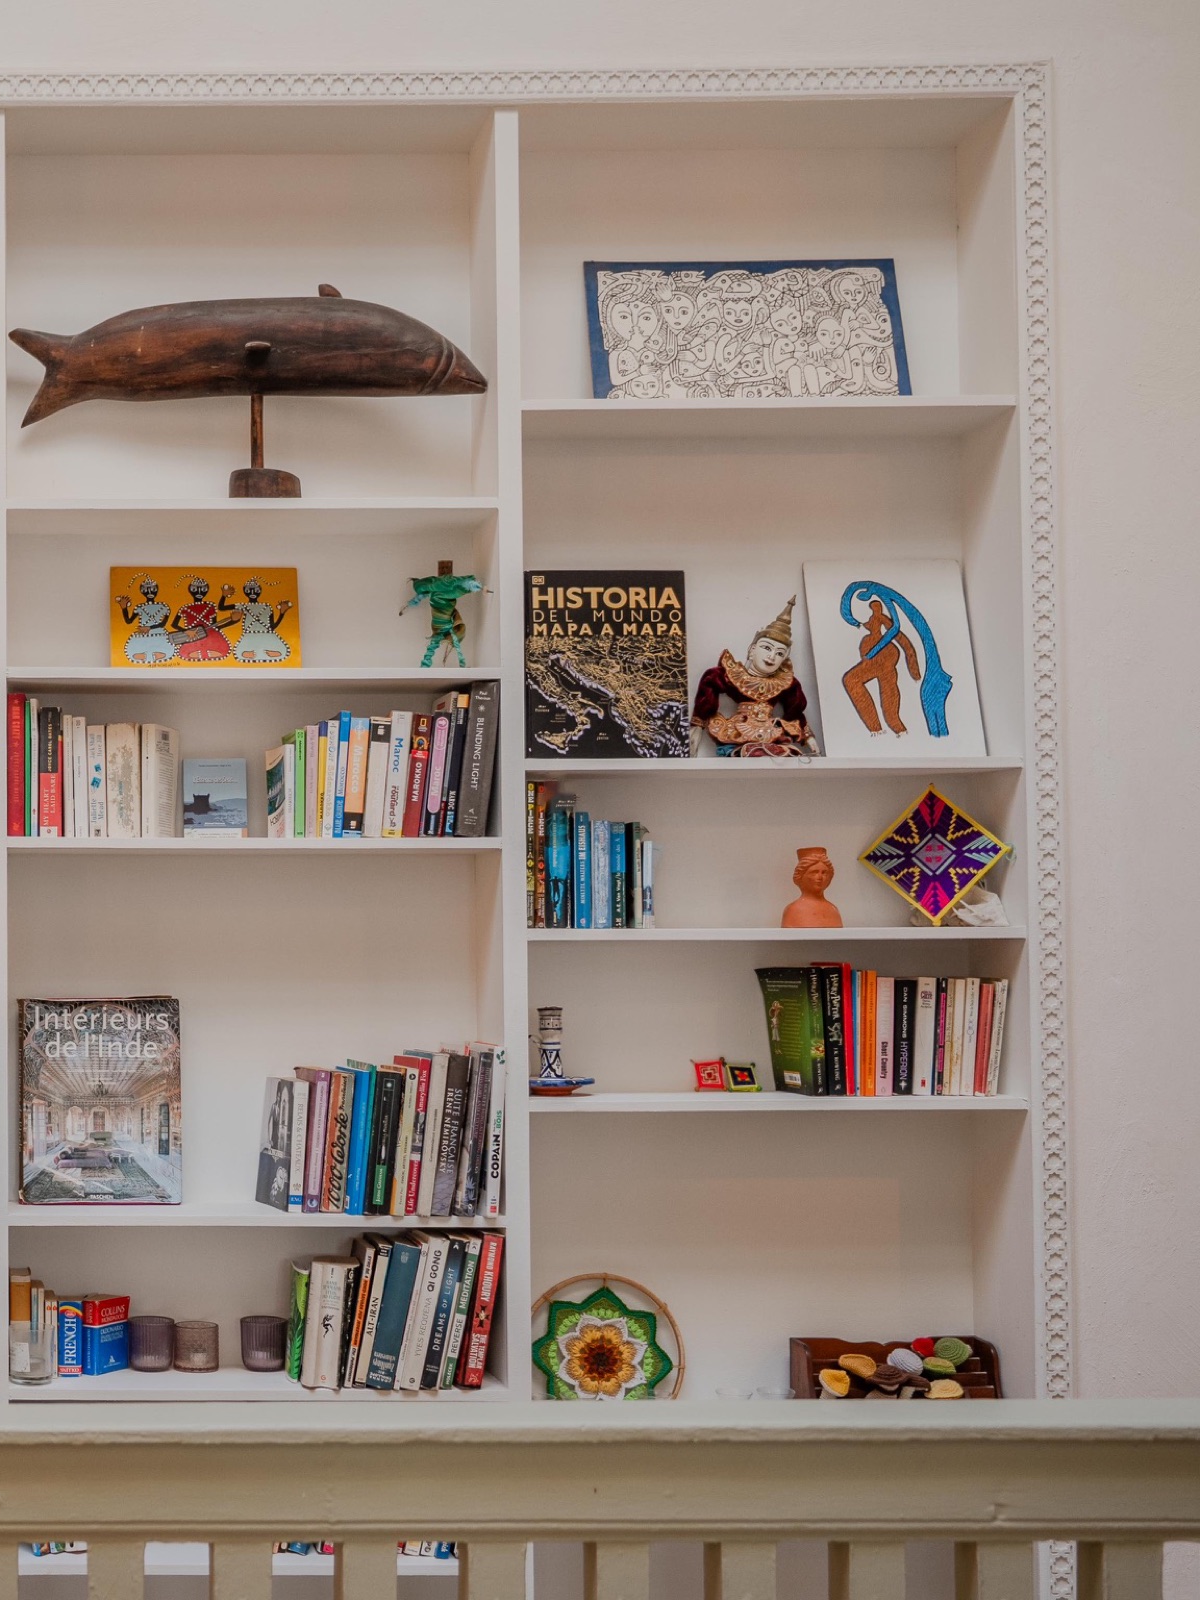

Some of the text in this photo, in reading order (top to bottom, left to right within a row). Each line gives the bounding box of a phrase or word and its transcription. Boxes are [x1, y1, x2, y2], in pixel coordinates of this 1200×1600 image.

[531, 587, 681, 609] HISTORIA
[532, 610, 682, 622] DEL MUNDO
[533, 623, 683, 636] MAPA A MAPA
[350, 744, 364, 794] Marocco
[391, 737, 404, 773] Maroc
[469, 717, 485, 791] BLINDING LIGHT
[49, 774, 57, 794] BARE
[338, 766, 346, 796] Morocco
[411, 761, 423, 802] MAROKKO
[429, 766, 442, 797] Maroc
[89, 798, 98, 825] Juliette
[96, 801, 104, 820] Mead
[335, 800, 344, 834] BLUE GUIDE
[388, 785, 398, 817] routard
[447, 790, 457, 810] MAROC
[43, 815, 50, 826] MY
[577, 825, 587, 860] IM EISHAUS
[579, 860, 587, 904] MINETTE WALTERS
[33, 1005, 171, 1030] Intérieurs
[44, 1032, 158, 1059] de l'Inde
[879, 1041, 889, 1080] Ghost Country
[899, 1041, 908, 1081] HYPERION
[296, 1103, 305, 1128] RELAIS
[446, 1088, 463, 1174] SUITE FRANÇAISE
[330, 1112, 349, 1165] Worte
[406, 1070, 428, 1211] Life Undercover Amaryllis Fox
[327, 1163, 343, 1210] 1000
[100, 1304, 127, 1318] COLLINS
[365, 1296, 379, 1338] ALT-IRAN
[413, 1250, 443, 1357] YVES REQUENA QI GONG
[431, 1267, 455, 1351] DREAMS OF LIGHT
[448, 1259, 475, 1354] REVERSE MEDITATION
[476, 1241, 498, 1370] RAYMOND KHOURY THE TEMPLAR
[64, 1318, 77, 1366] FRENCH
[467, 1332, 481, 1370] SALVATION
